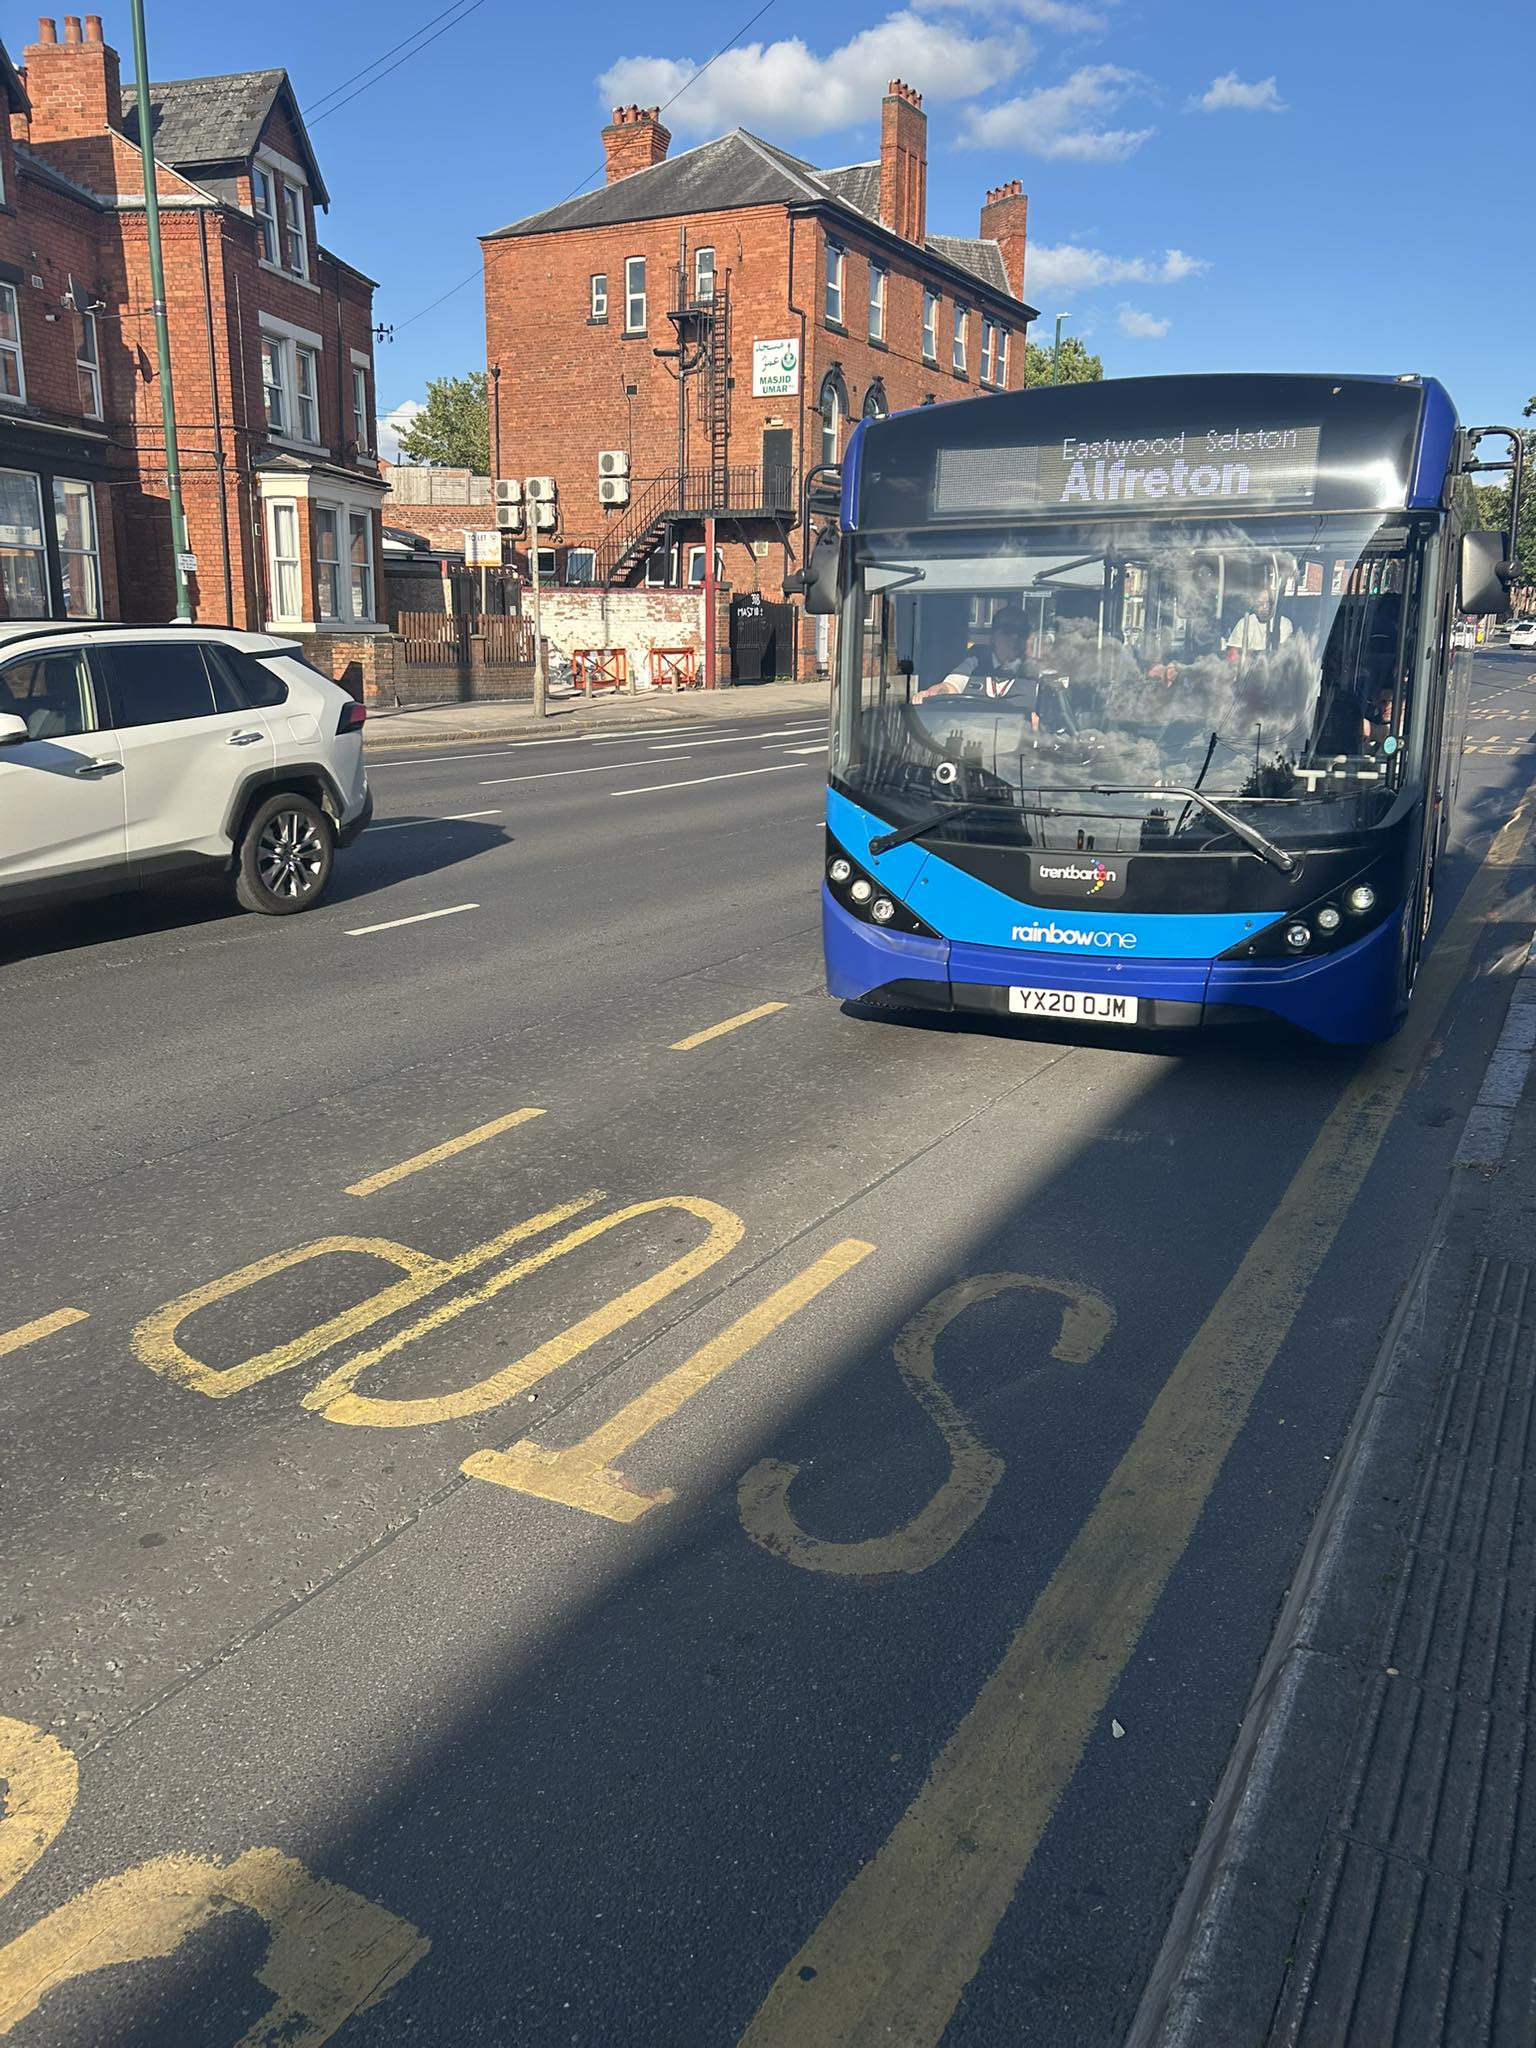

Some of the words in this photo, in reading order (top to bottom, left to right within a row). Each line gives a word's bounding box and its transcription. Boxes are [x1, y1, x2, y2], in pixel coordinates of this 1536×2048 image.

[760, 375, 791, 385] MASJID
[762, 385, 788, 394] UMAR
[1061, 431, 1186, 460] Eastwood
[1205, 428, 1298, 453] Selston
[1059, 457, 1250, 503] Alfreton
[1039, 863, 1117, 882] trentbarton
[1019, 989, 1076, 1012] YX20
[1082, 996, 1127, 1019] OJM
[130, 1189, 1118, 1576] STOP
